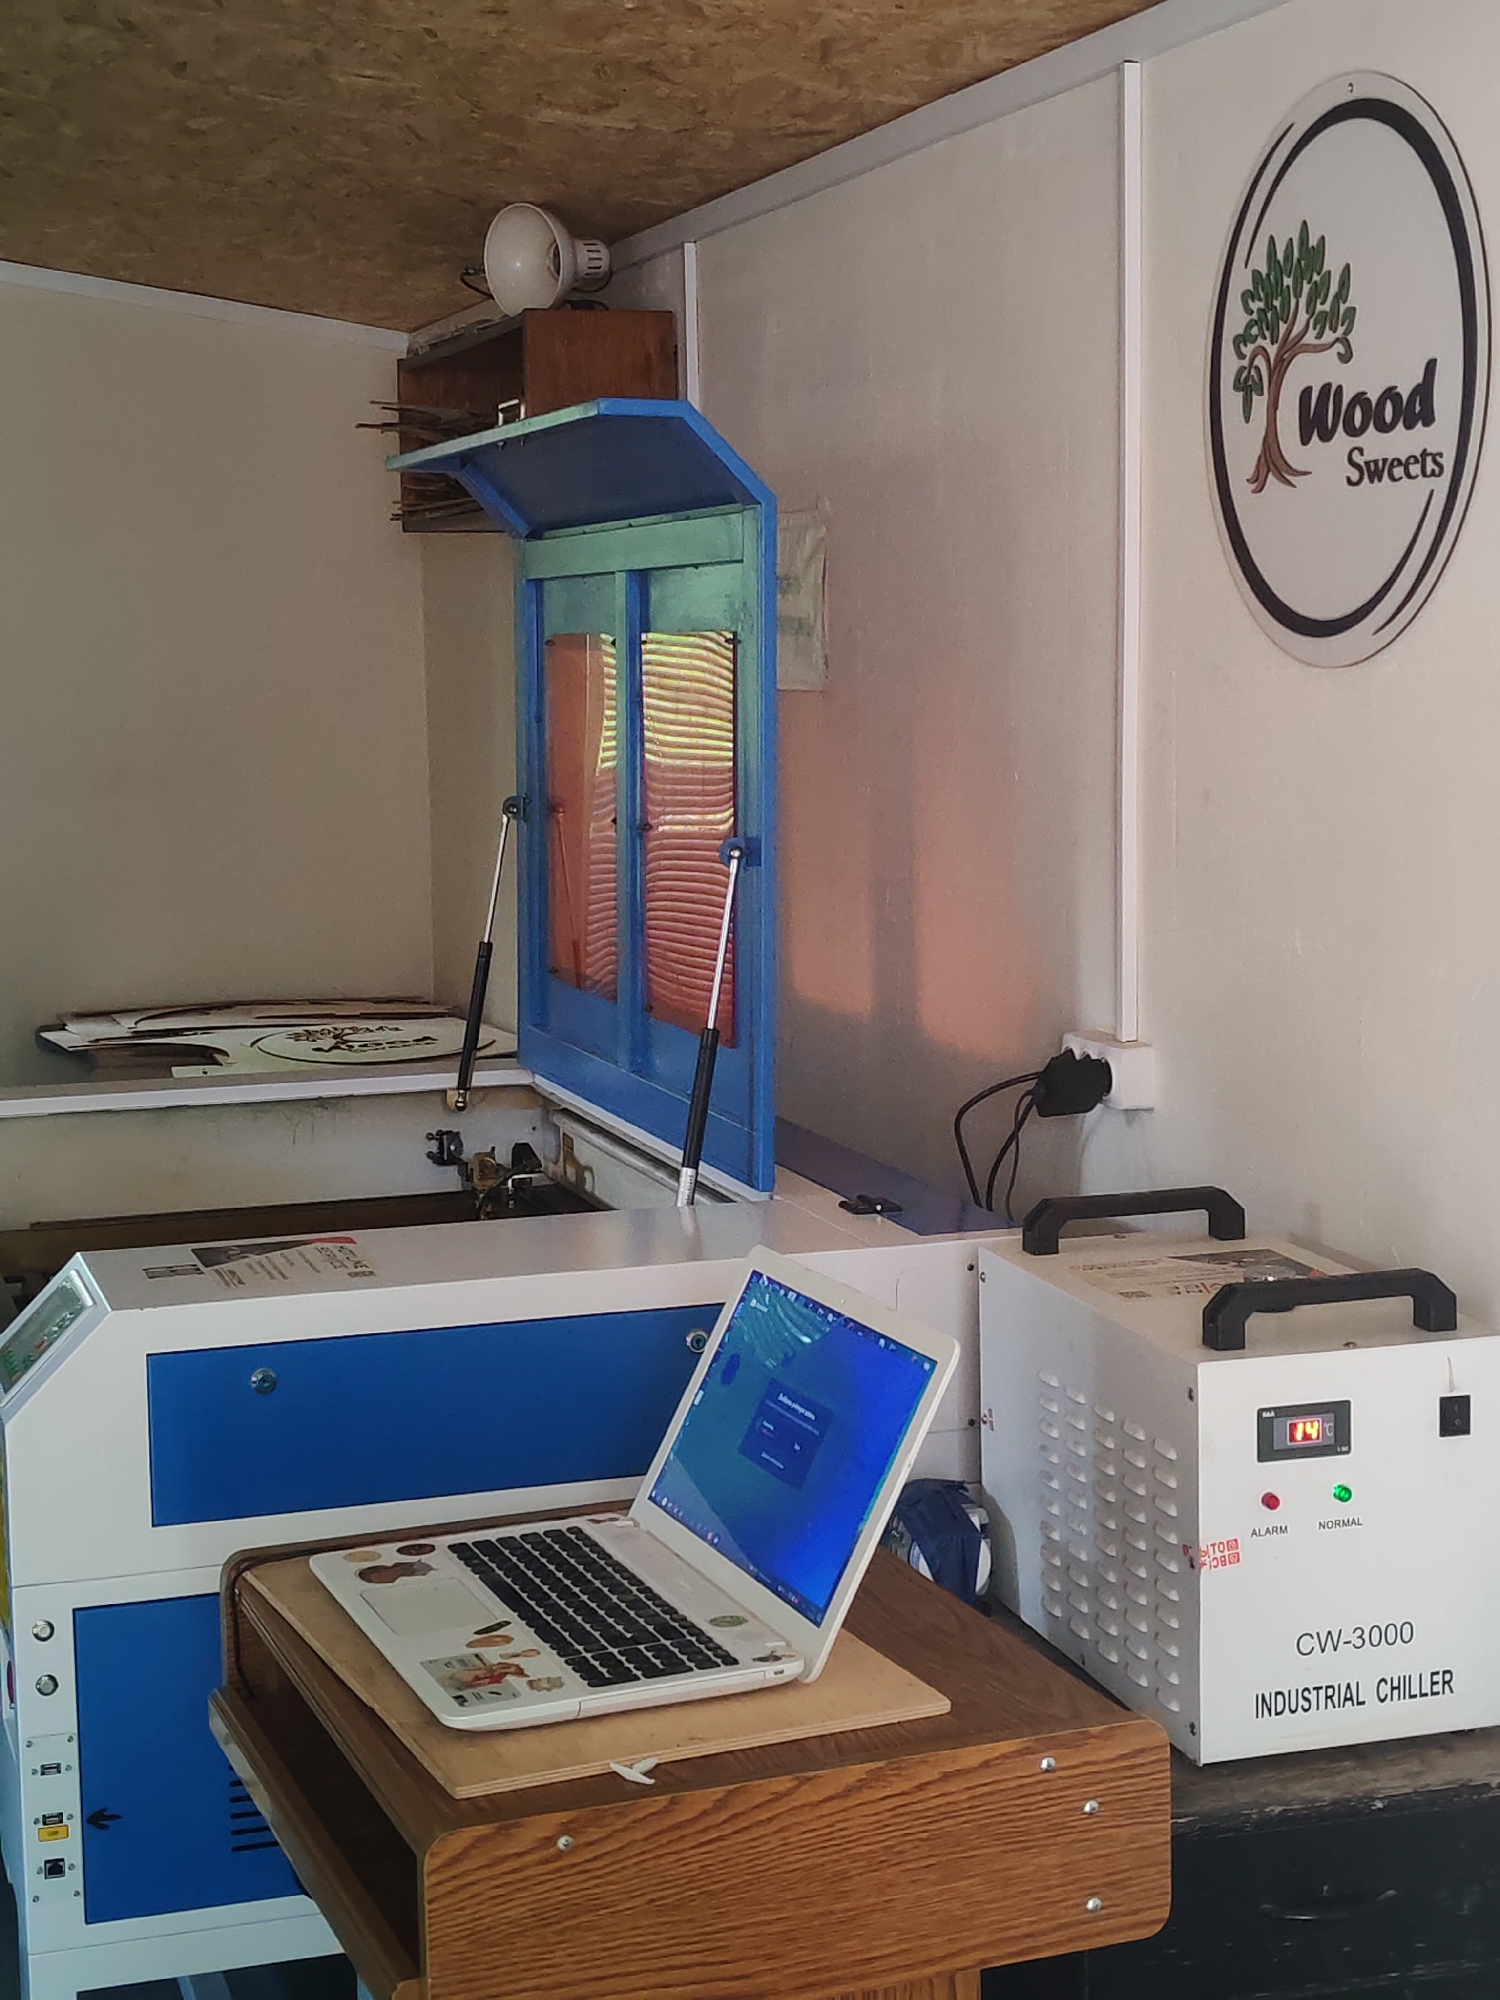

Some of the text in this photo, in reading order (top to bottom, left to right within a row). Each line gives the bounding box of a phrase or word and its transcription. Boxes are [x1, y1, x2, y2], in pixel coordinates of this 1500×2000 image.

[1299, 358, 1437, 446] Wood
[1346, 447, 1444, 487] Sweets
[1295, 1420, 1319, 1441] 14
[1250, 1525, 1289, 1538] ALARM
[1318, 1517, 1363, 1530] NORMAL
[1296, 1621, 1414, 1656] CW-3000
[1255, 1669, 1454, 1719] INDUSTRIAL CHILLER
